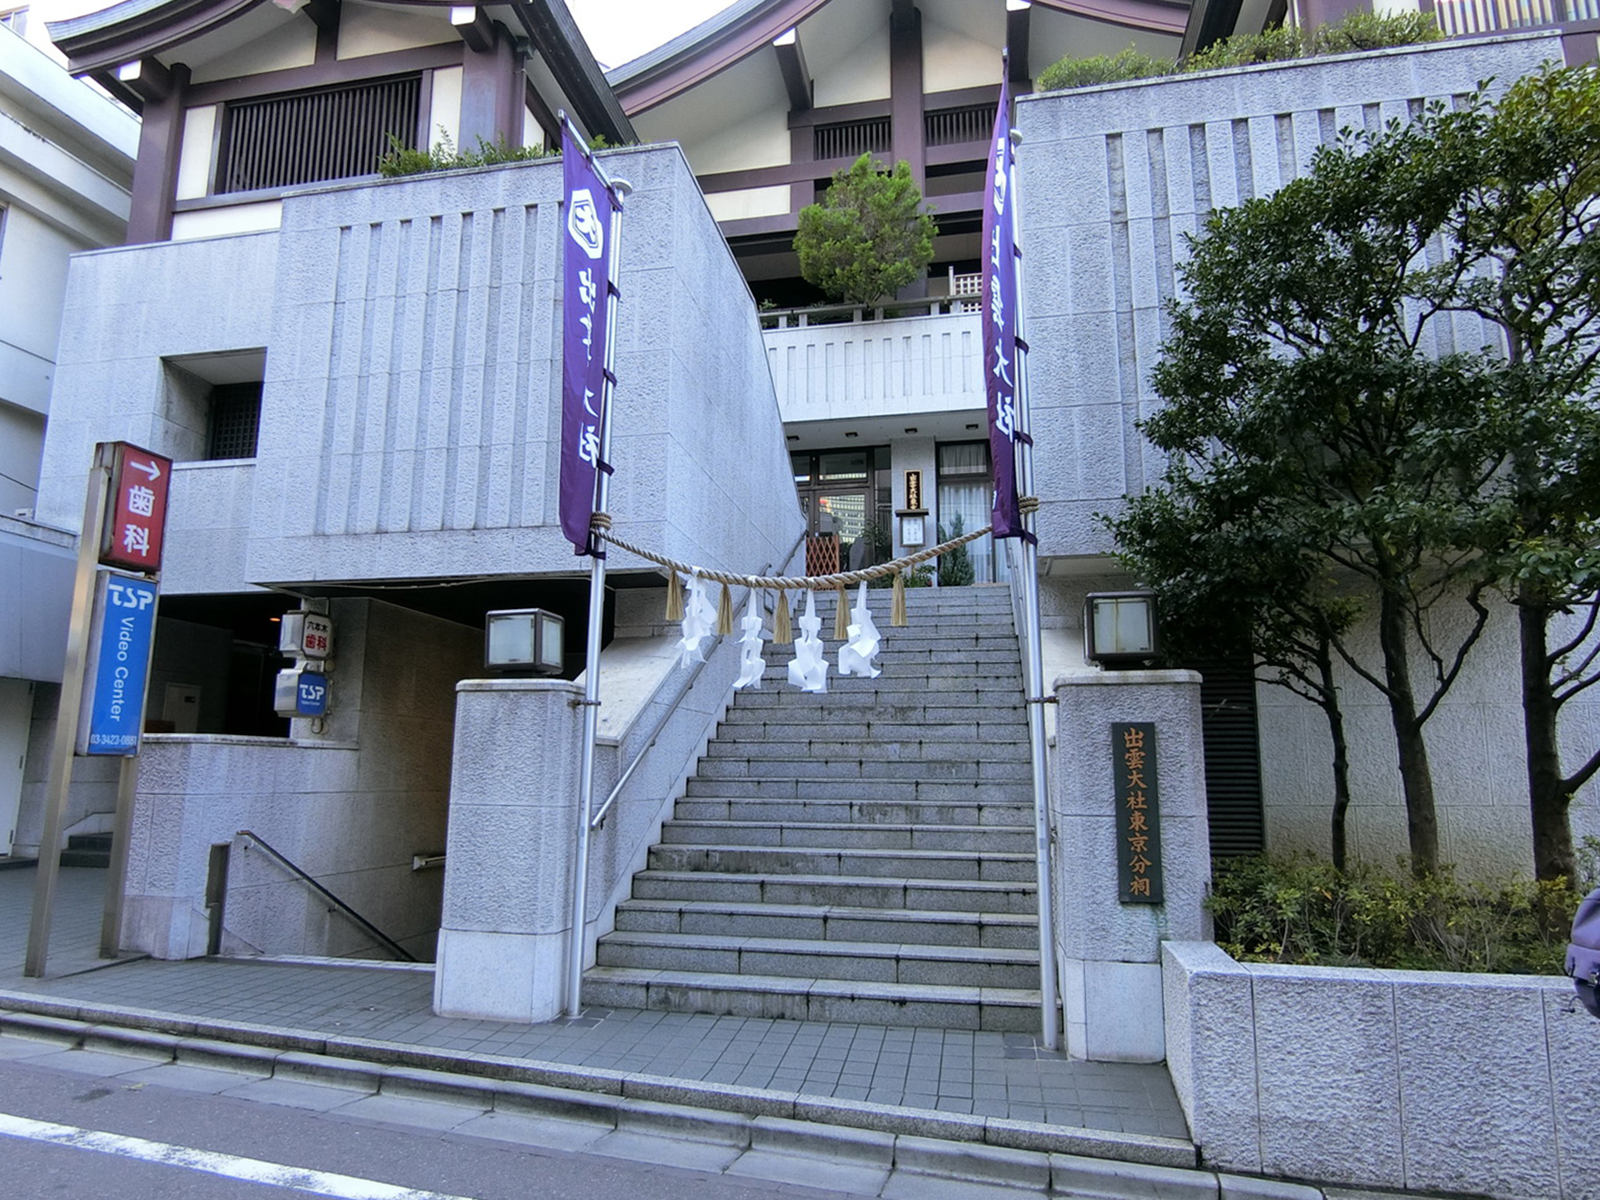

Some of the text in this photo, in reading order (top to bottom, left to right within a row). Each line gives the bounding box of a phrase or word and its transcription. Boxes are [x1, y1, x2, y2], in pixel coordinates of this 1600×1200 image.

[123, 485, 156, 557] 歯科
[108, 584, 154, 611] TSP
[306, 621, 329, 633] 六本木
[305, 633, 327, 651] 歯科
[110, 616, 135, 722] Video Center
[299, 684, 325, 701] TSP
[1123, 727, 1152, 897] 出雲大社東京分祠
